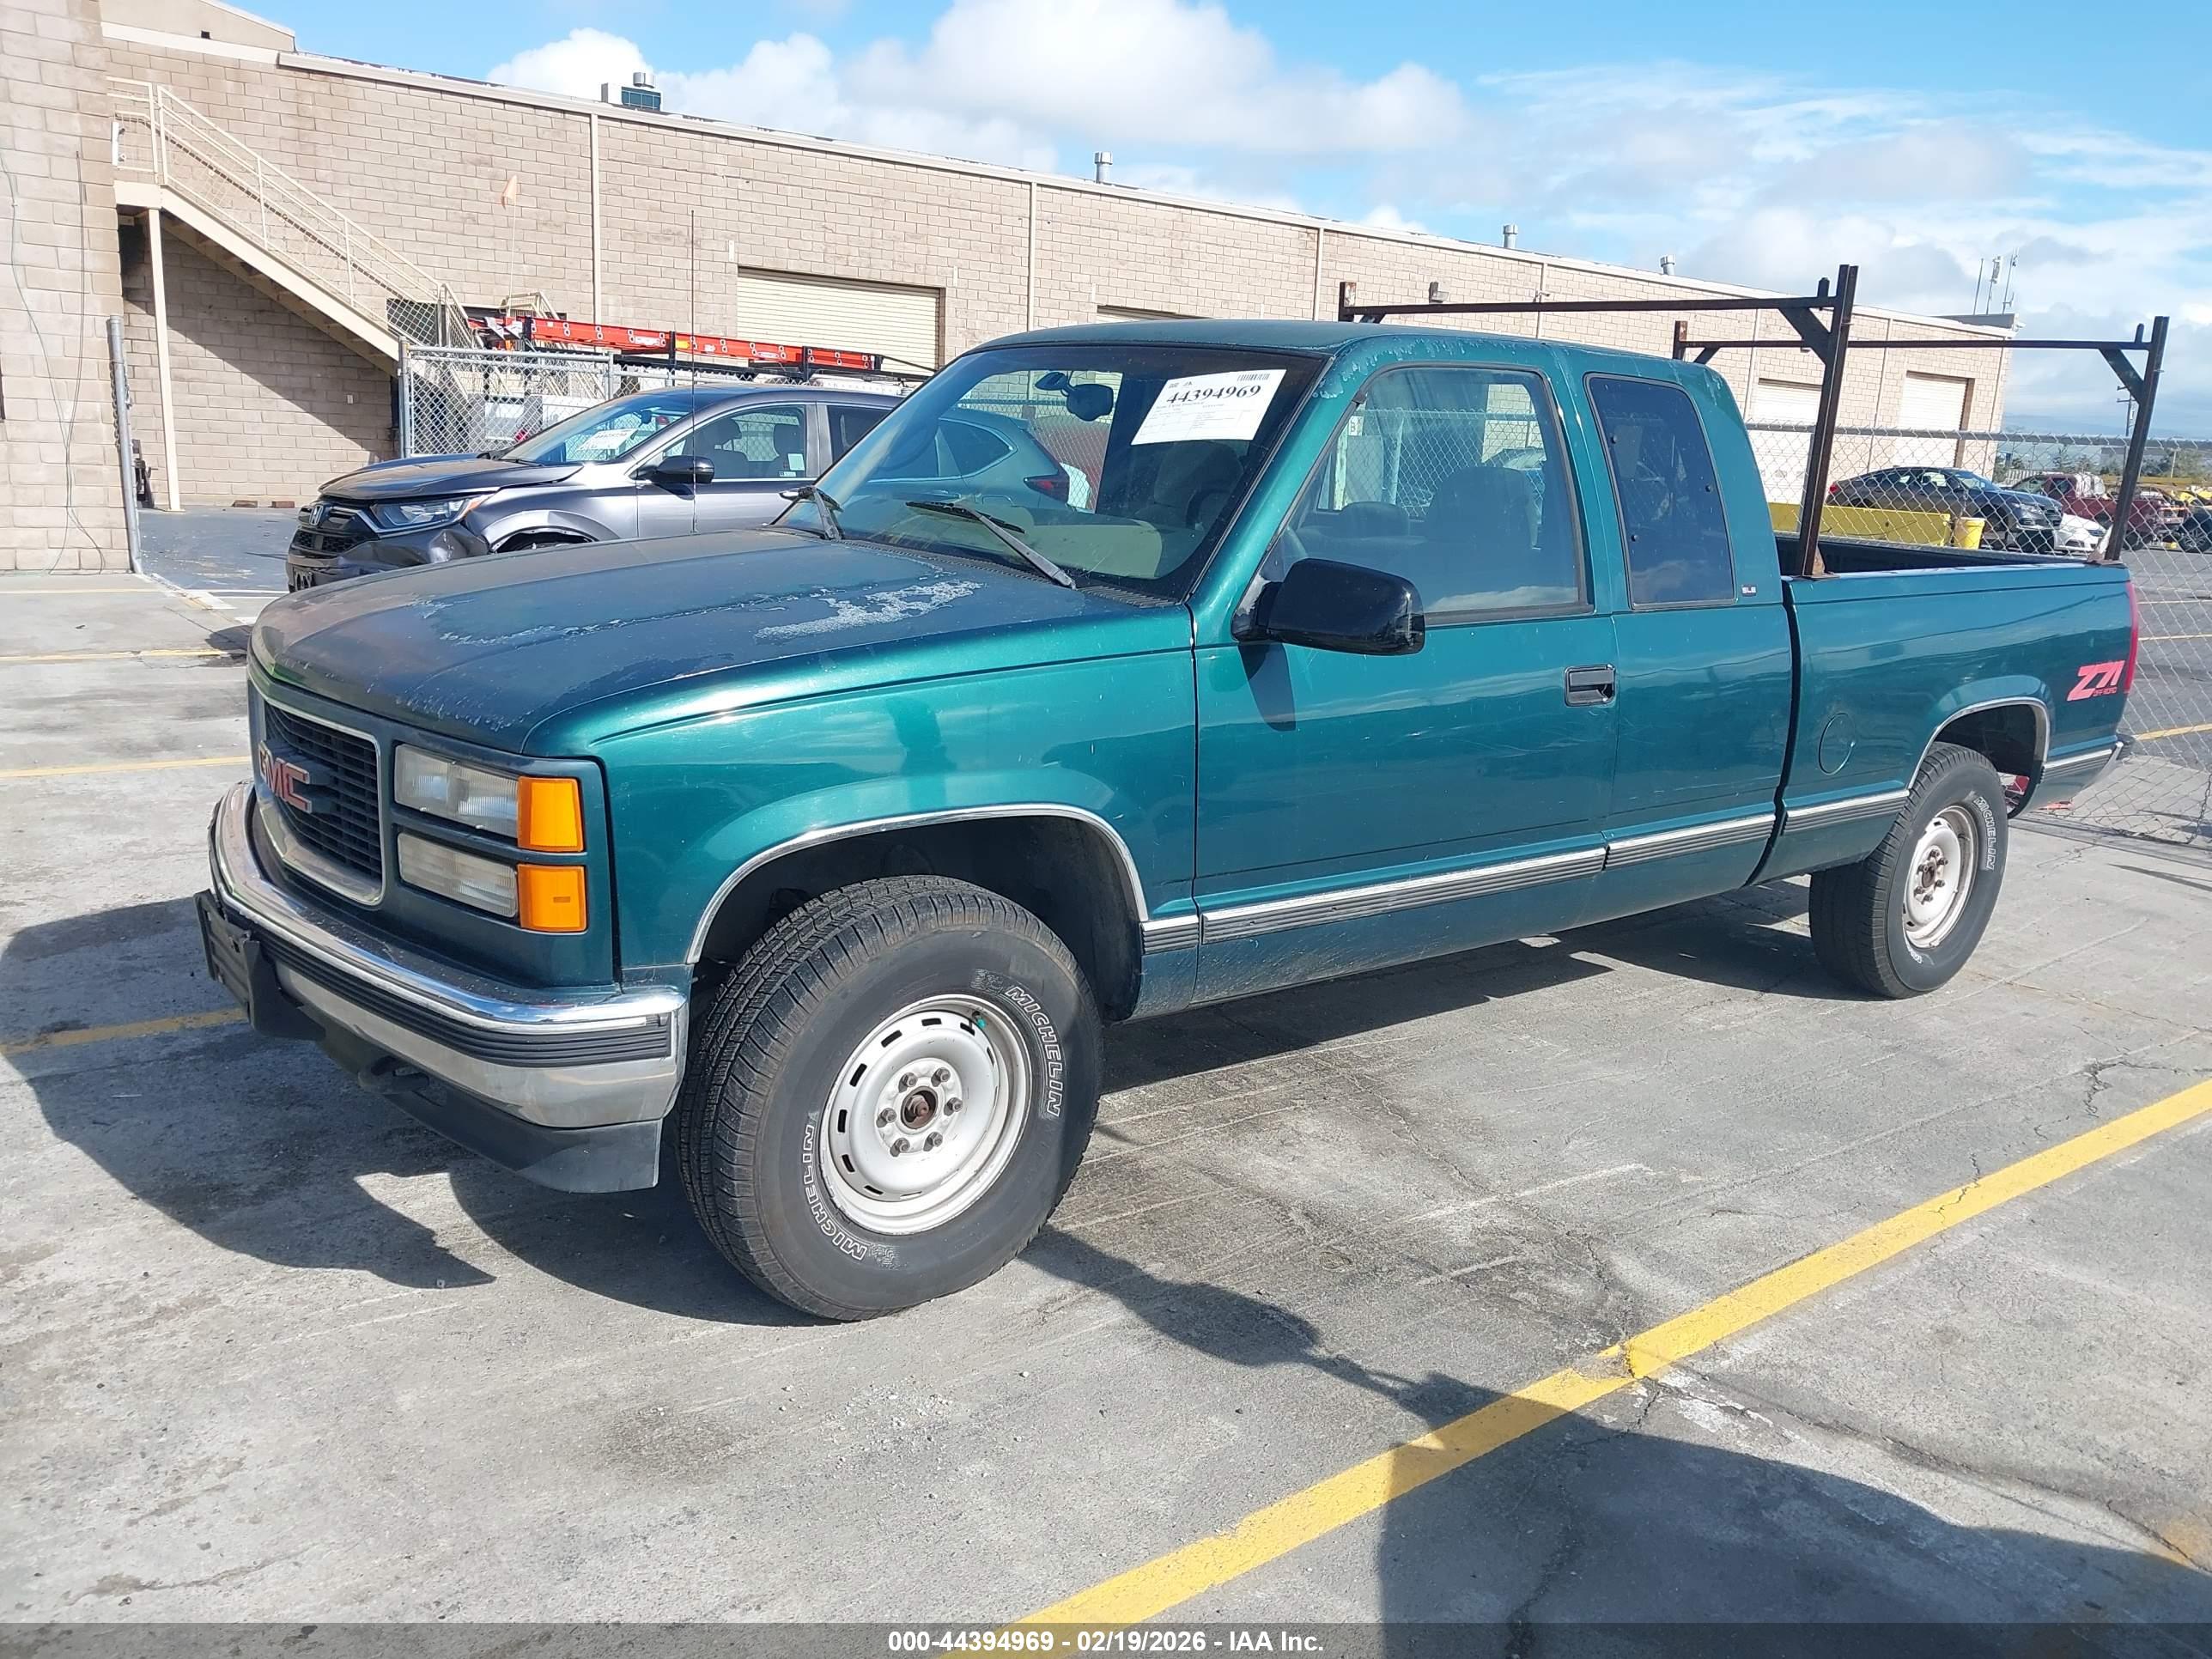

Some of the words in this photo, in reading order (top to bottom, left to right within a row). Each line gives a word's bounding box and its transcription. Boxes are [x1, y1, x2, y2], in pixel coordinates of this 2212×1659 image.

[1166, 385, 1261, 404] 44394969
[2067, 659, 2125, 702] Z71
[258, 740, 313, 814] GMC
[1973, 796, 1996, 871] MICHELIN
[1005, 986, 1064, 1117] MICHELIN
[802, 1123, 868, 1261] MICHELIN
